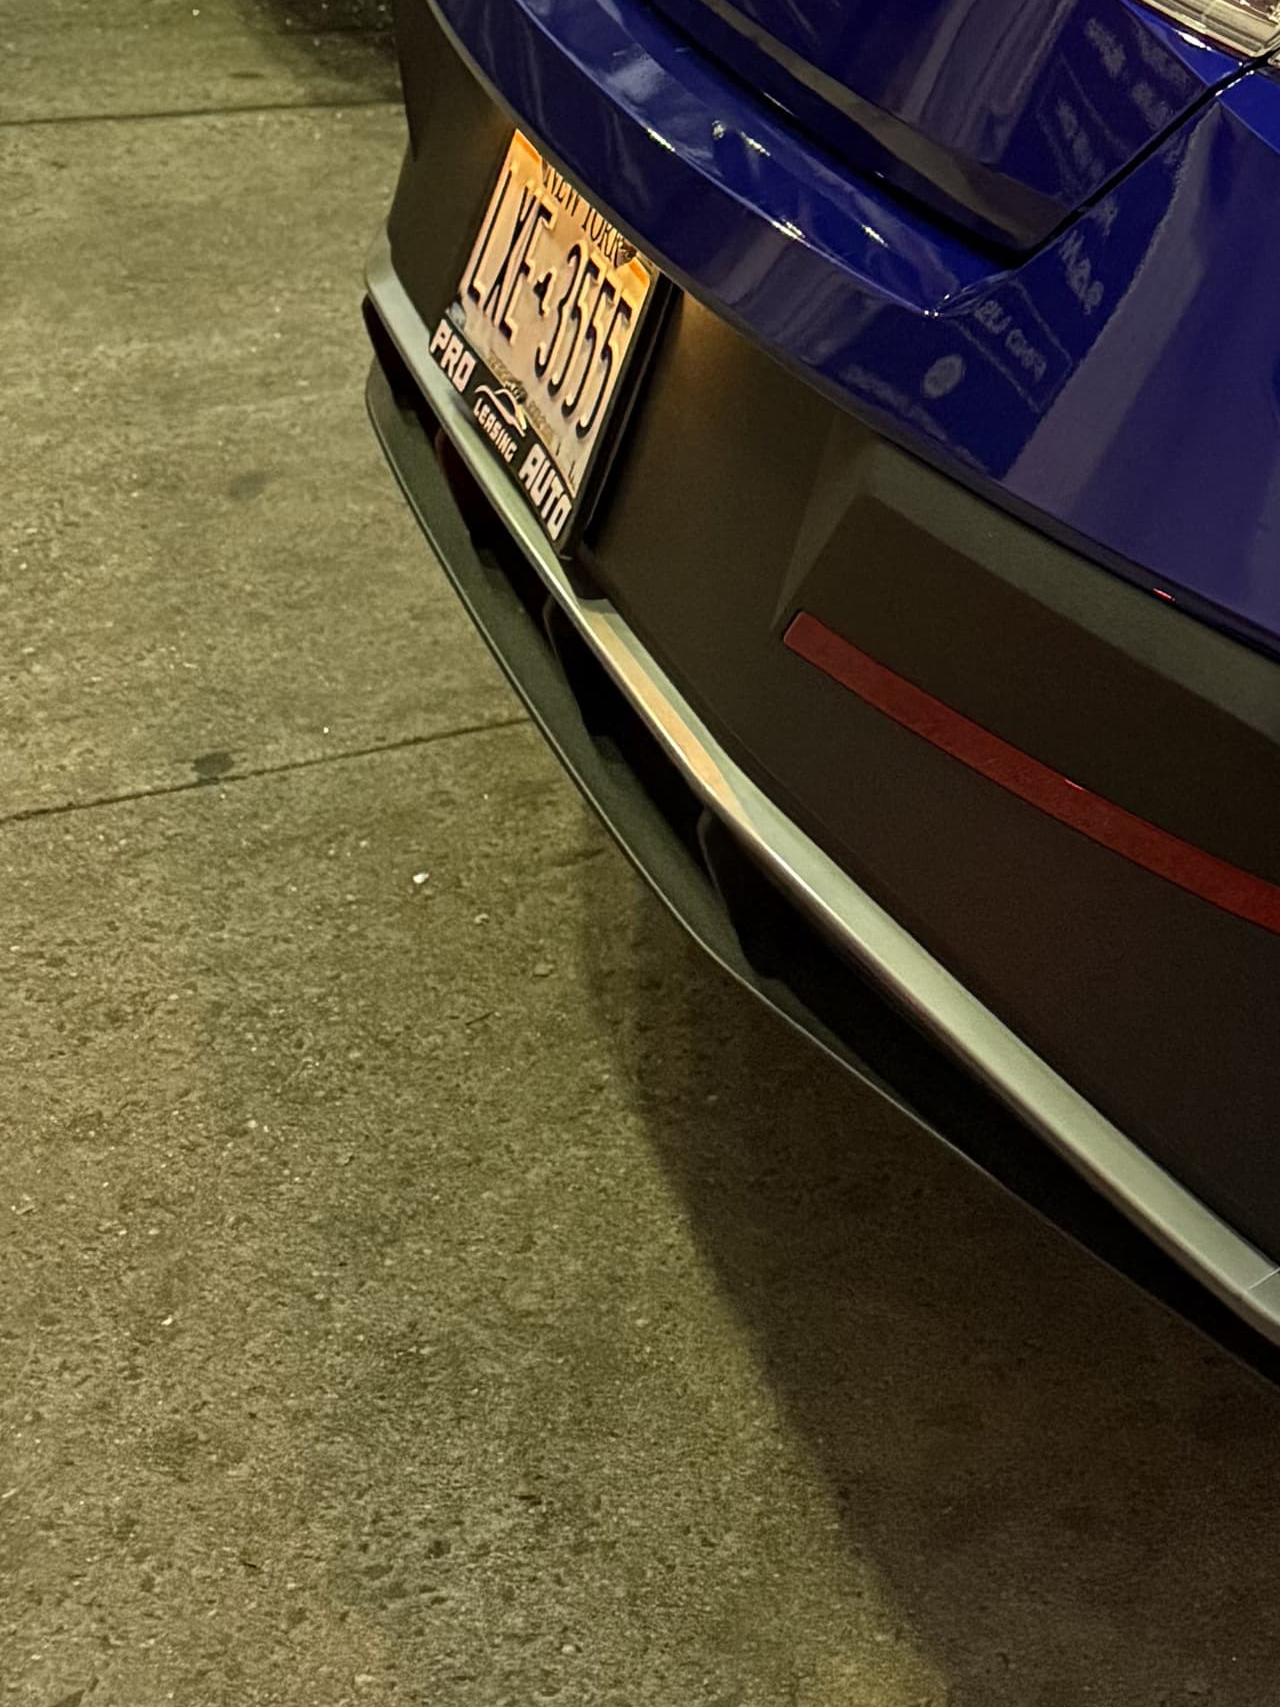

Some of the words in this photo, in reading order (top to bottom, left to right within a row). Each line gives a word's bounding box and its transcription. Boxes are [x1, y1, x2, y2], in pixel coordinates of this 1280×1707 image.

[430, 318, 477, 393] PRO
[473, 397, 518, 464] LEASING
[518, 443, 573, 541] AUTO
